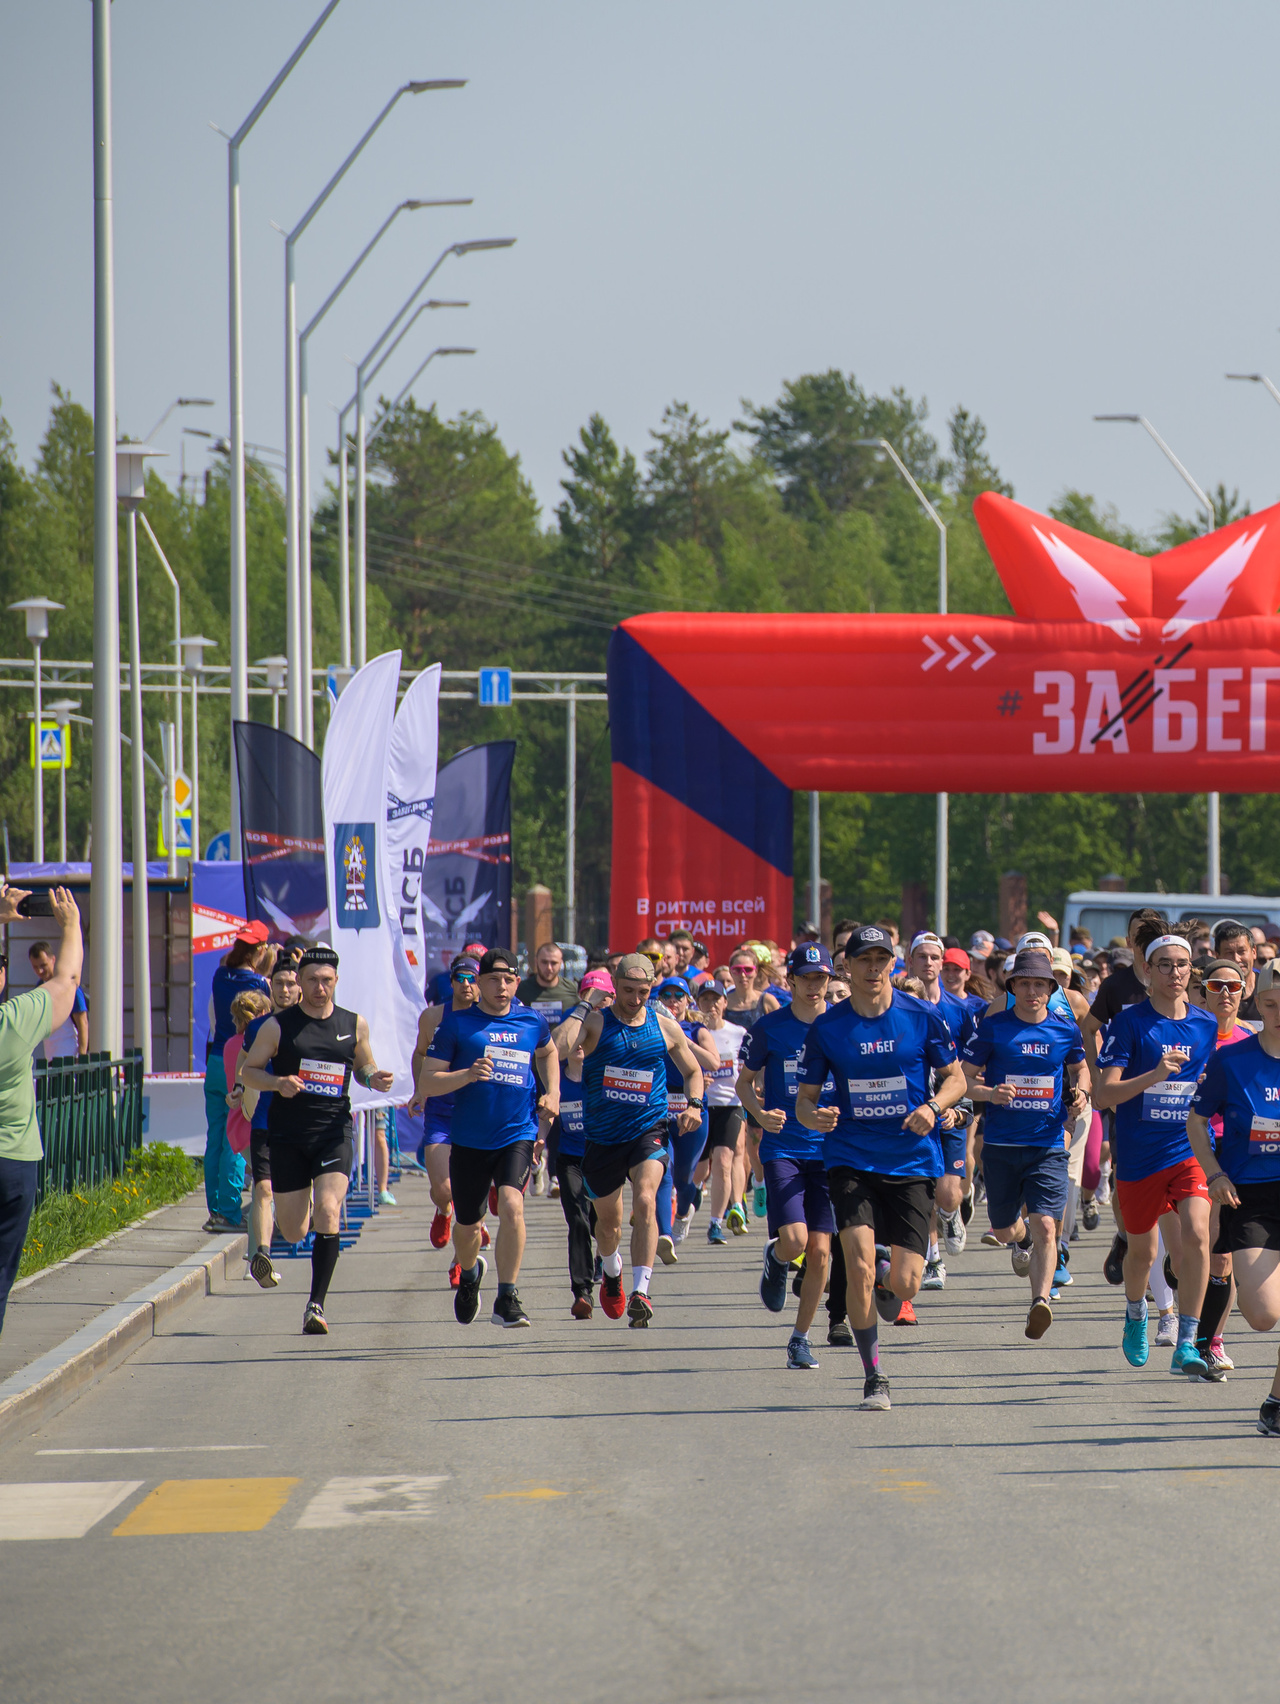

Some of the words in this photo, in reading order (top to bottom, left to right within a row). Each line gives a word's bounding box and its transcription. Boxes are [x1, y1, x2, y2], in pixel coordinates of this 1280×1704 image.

[637, 898, 649, 915] В
[656, 900, 716, 917] ритме
[722, 896, 765, 913] всей
[655, 919, 746, 937] СТРАНЫ!
[303, 1082, 339, 1096] 0043
[605, 1089, 646, 1103] 10003
[853, 1104, 907, 1118] 50009
[1009, 1099, 1050, 1110] 10089
